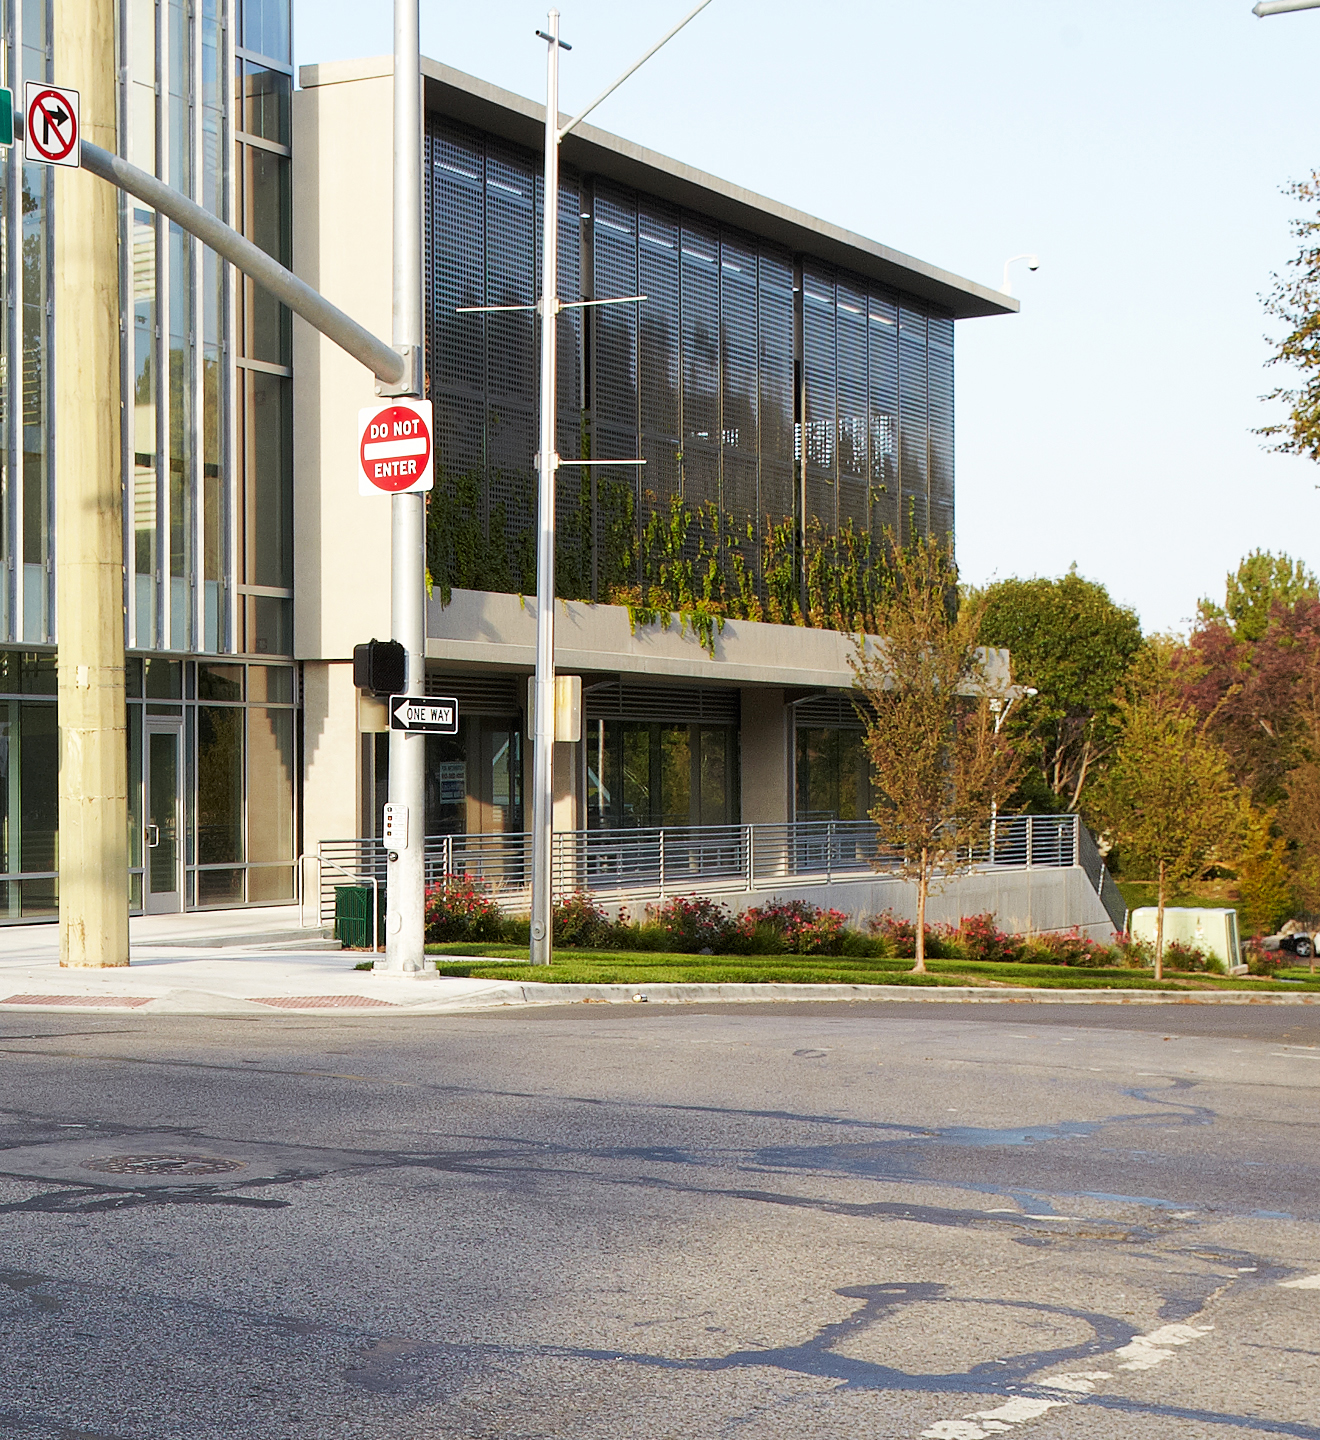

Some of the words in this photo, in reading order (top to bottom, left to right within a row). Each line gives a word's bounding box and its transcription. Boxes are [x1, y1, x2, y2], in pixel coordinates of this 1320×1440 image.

[370, 423, 389, 440] DO
[393, 418, 420, 437] NOT
[374, 459, 417, 478] ENTER
[407, 707, 426, 721] ONE
[430, 708, 450, 722] WAY
